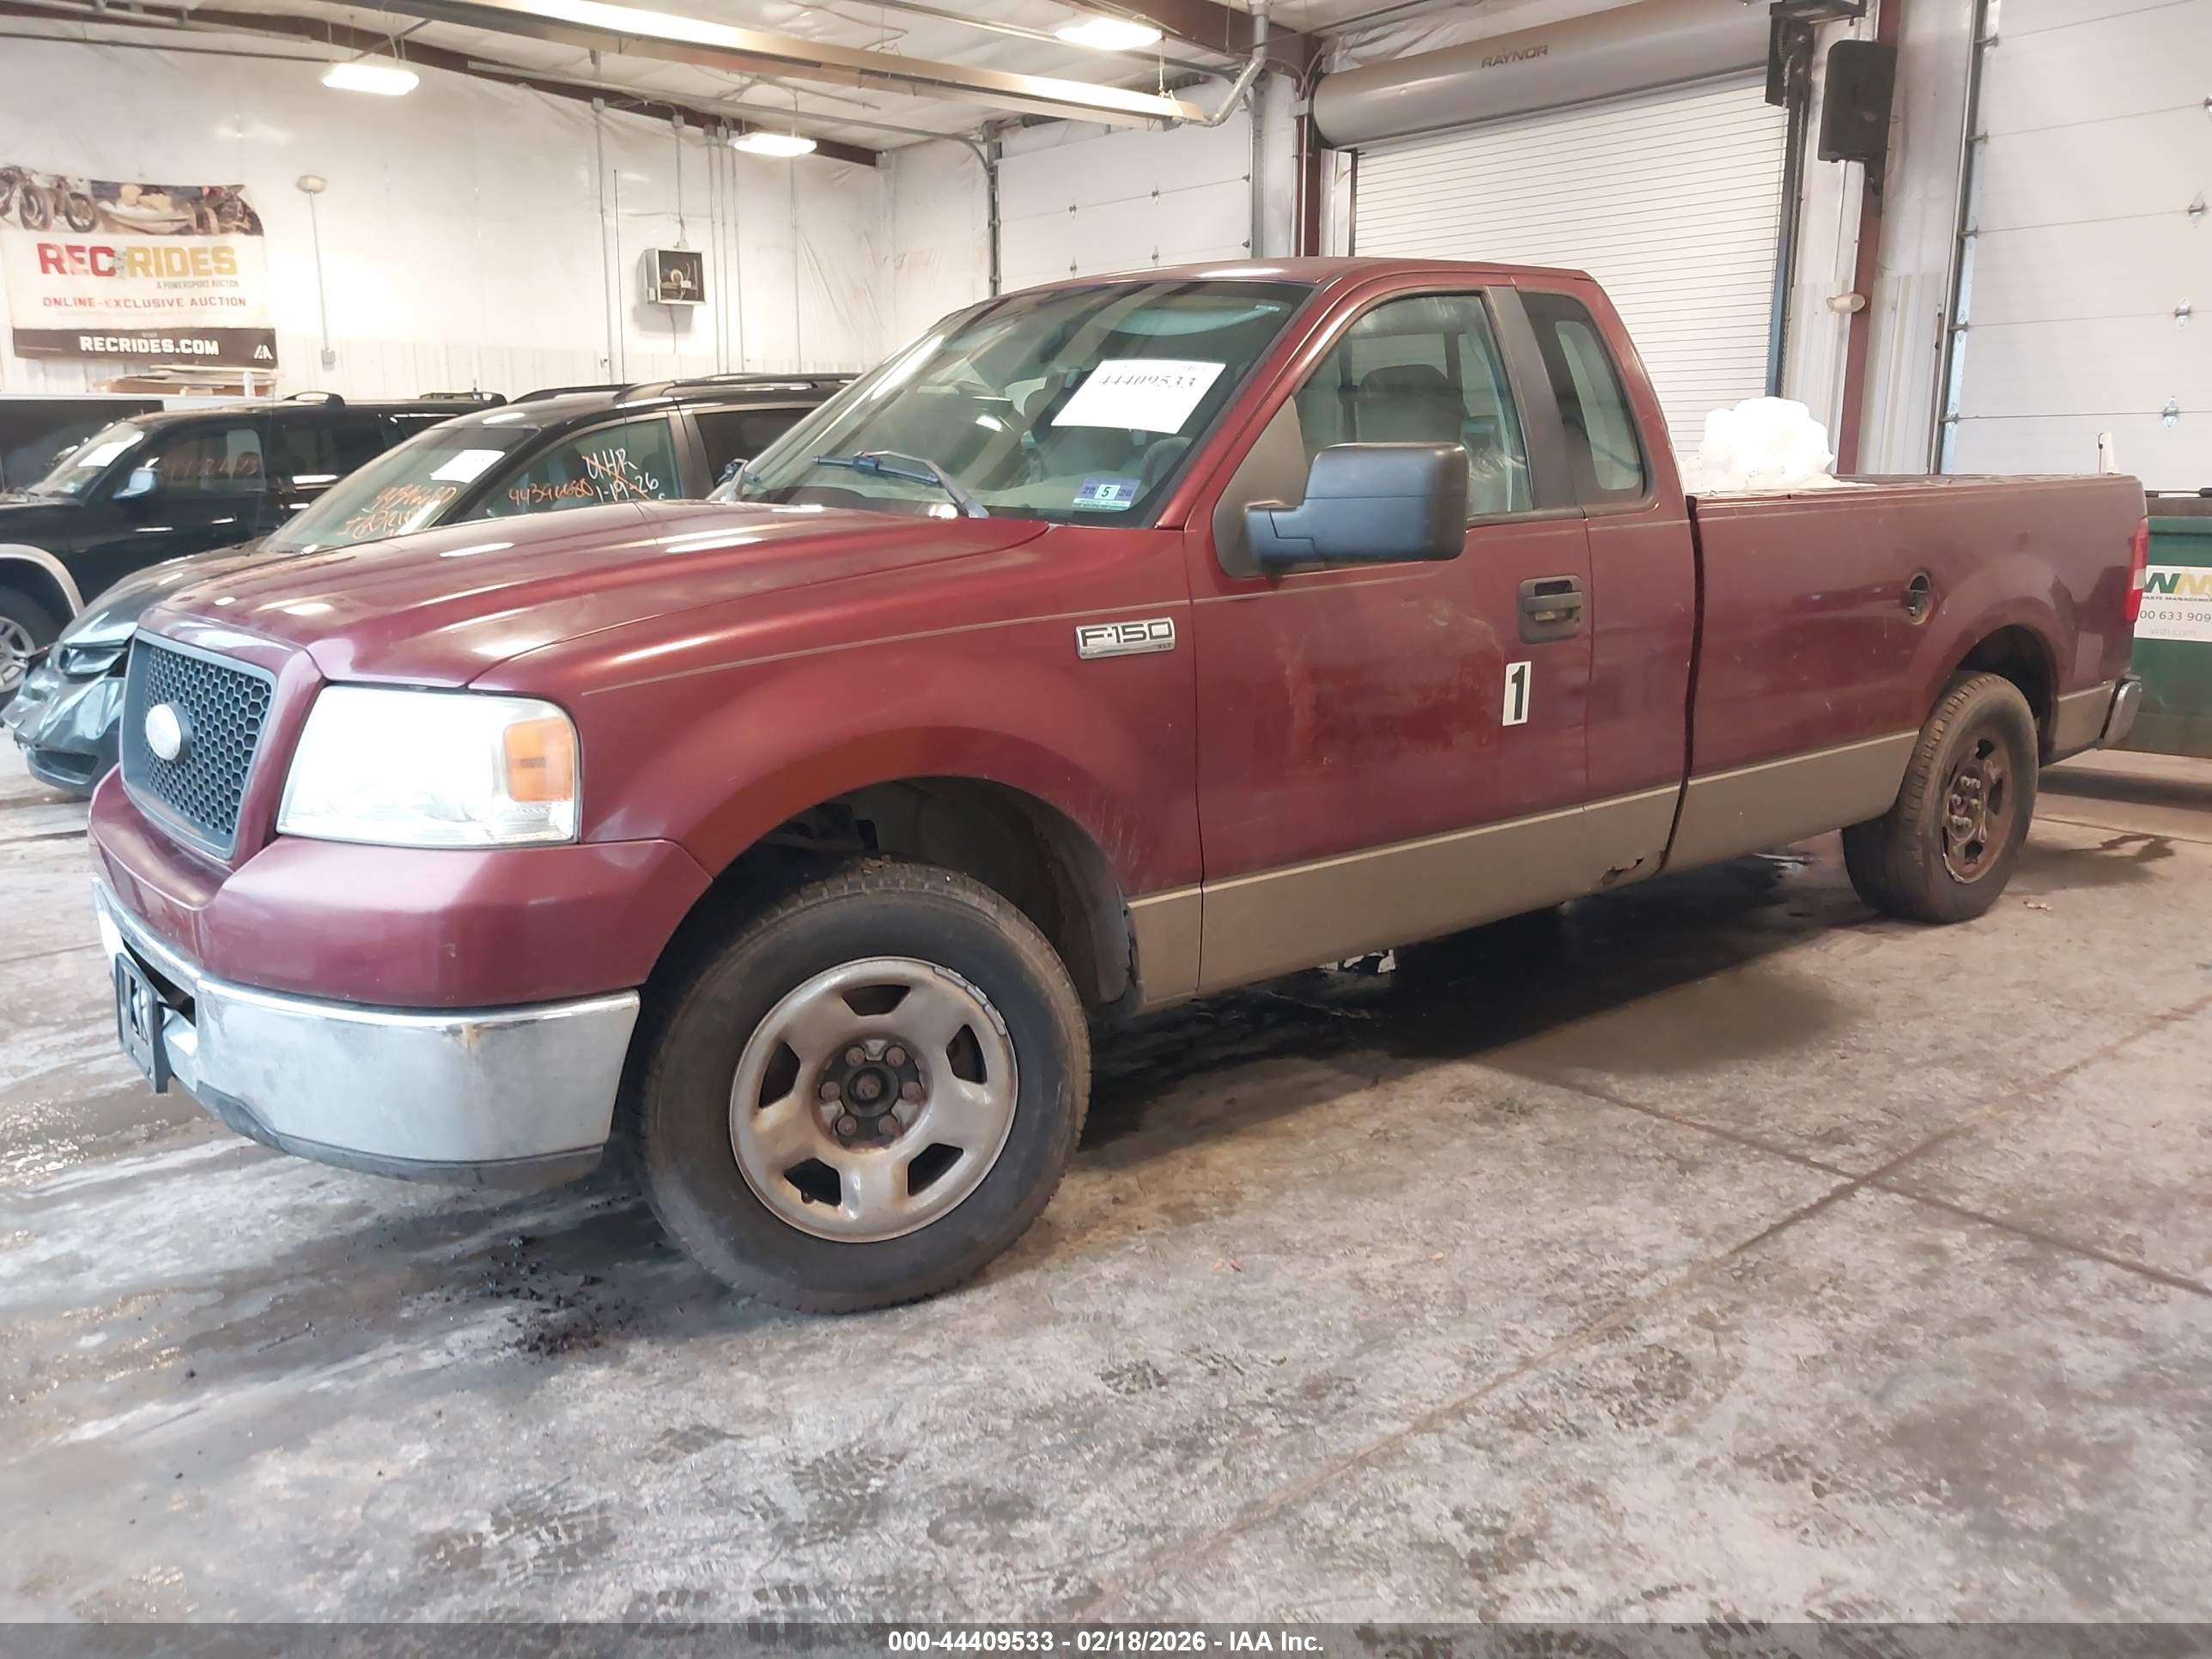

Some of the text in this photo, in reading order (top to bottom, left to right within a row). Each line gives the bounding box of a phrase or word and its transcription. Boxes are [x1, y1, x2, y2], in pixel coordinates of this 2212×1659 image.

[1480, 45, 1549, 69] RAYNOR
[37, 243, 238, 277] REC RIDES
[212, 279, 240, 288] AUCTION
[43, 296, 246, 309] ONLINE-EXCLUSIVE AUCTION
[80, 336, 220, 356] RECRIDES.COM
[1101, 486, 1111, 497] 5
[2139, 610, 2211, 623] 00 633 909
[1080, 621, 1172, 647] F-150
[1511, 665, 1526, 720] 1
